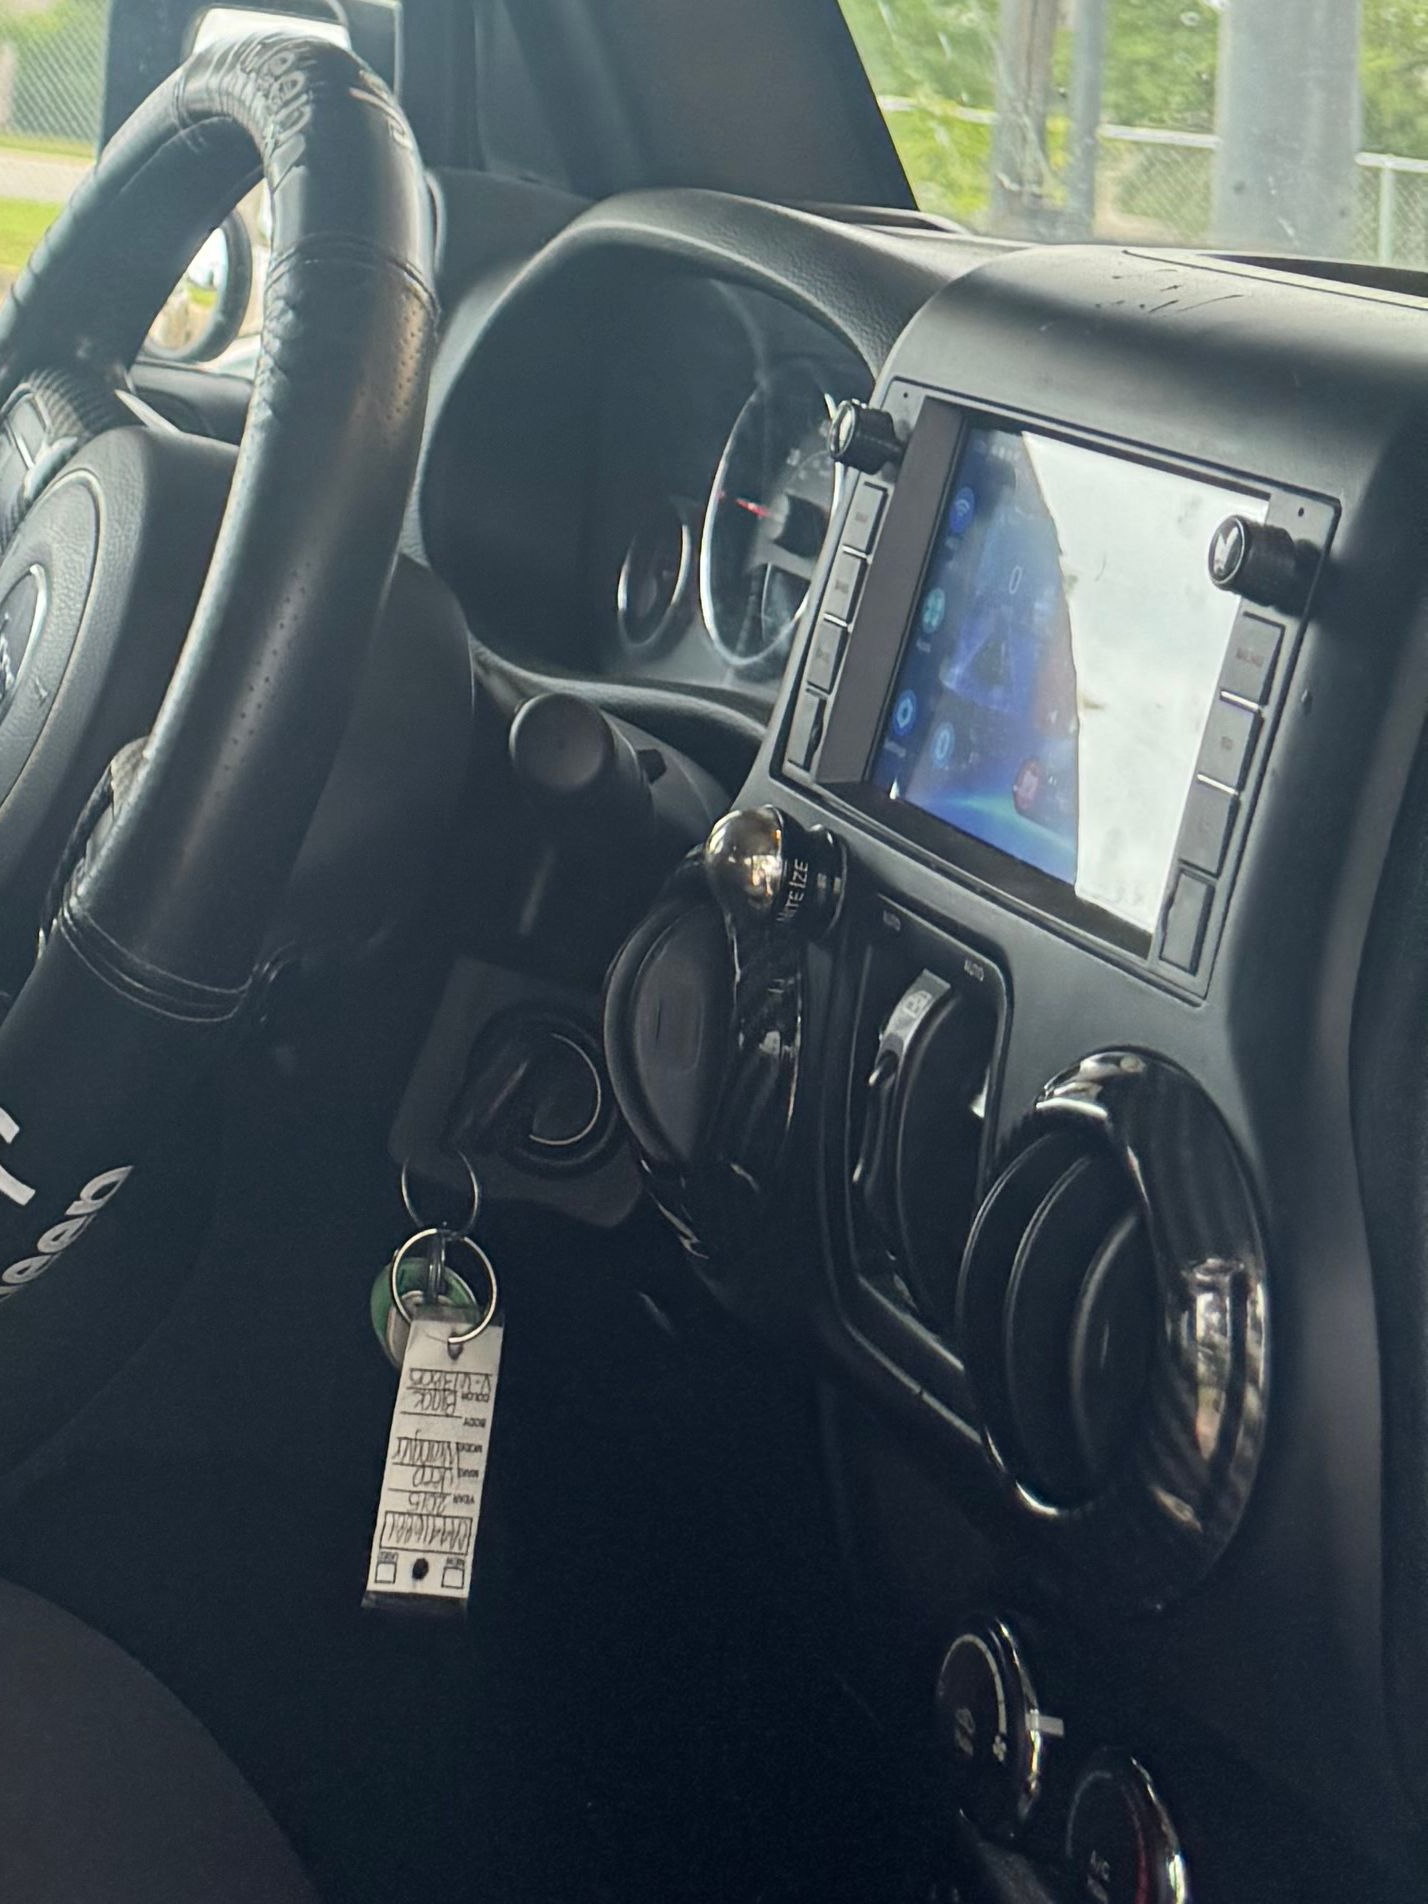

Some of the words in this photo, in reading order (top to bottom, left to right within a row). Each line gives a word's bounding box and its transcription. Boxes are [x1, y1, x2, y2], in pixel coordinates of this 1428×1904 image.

[963, 959, 985, 983] AUTO
[463, 1417, 486, 1429] BODY
[408, 1490, 448, 1513] 2015
[453, 1493, 476, 1505] YEAR
